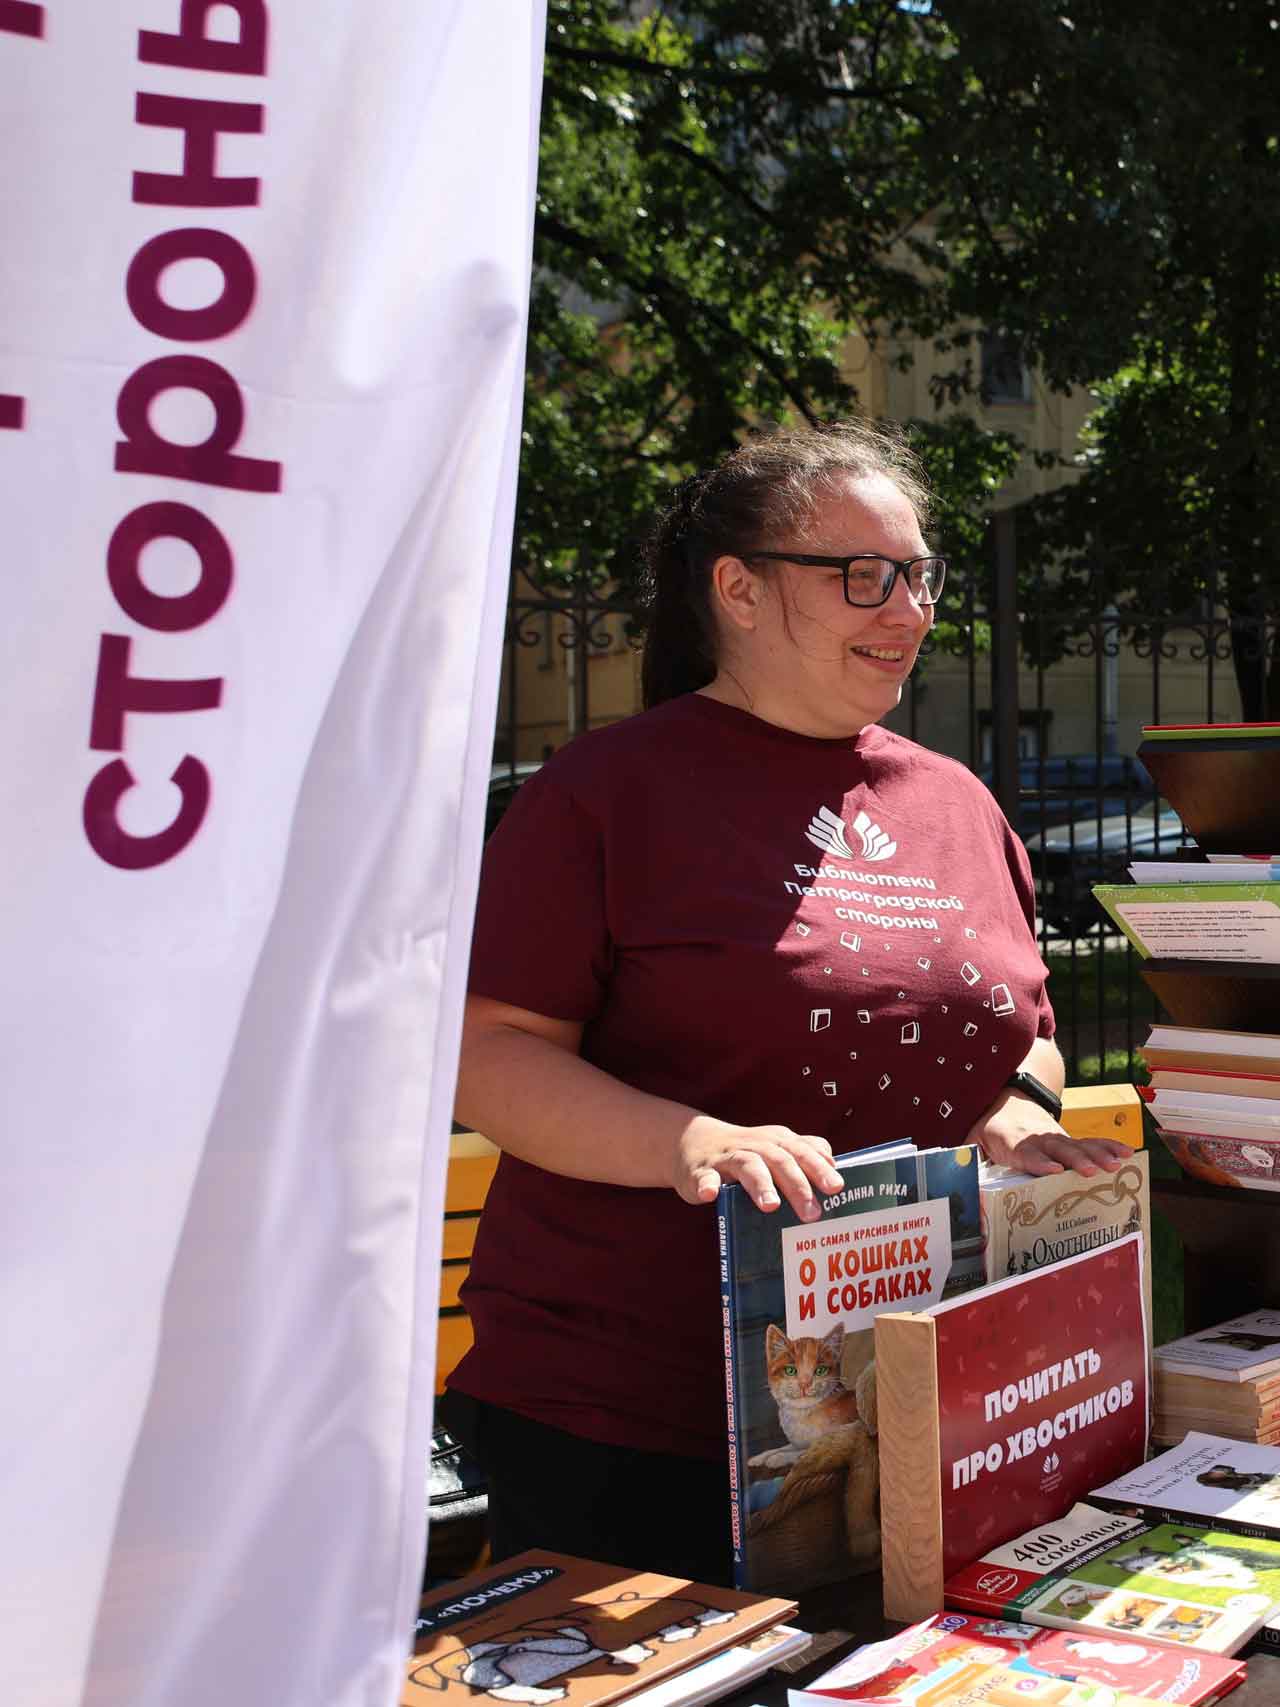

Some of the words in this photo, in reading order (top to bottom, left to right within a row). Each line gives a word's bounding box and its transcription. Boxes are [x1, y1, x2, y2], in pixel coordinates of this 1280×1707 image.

[794, 863, 937, 890] Библиотеки
[784, 881, 965, 911] Петроградской
[835, 907, 939, 929] стороны
[823, 1185, 875, 1211] СЮЗАННА
[879, 1184, 908, 1196] РИХА
[718, 1216, 729, 1256] СЮЗАННА
[796, 1239, 817, 1252] МОЯ
[821, 1232, 850, 1247] САМАЯ
[854, 1224, 899, 1241] КРАСИВАЯ
[903, 1216, 931, 1232] КНИГА
[720, 1259, 729, 1282] РИХА
[799, 1258, 816, 1287] О
[828, 1235, 929, 1282] КОШКАХ
[799, 1292, 816, 1321] И
[826, 1268, 933, 1314] СОБАКАХ
[983, 1347, 1101, 1423] ПОЧИТАТЬ
[952, 1442, 1004, 1490] ПРО
[1006, 1379, 1134, 1464] ХВОСТИКОВ
[1013, 1532, 1064, 1563] 400
[1036, 1519, 1129, 1568] советов
[1063, 1538, 1121, 1573] любителю
[437, 1568, 554, 1618] «ПОЧЕМУ»
